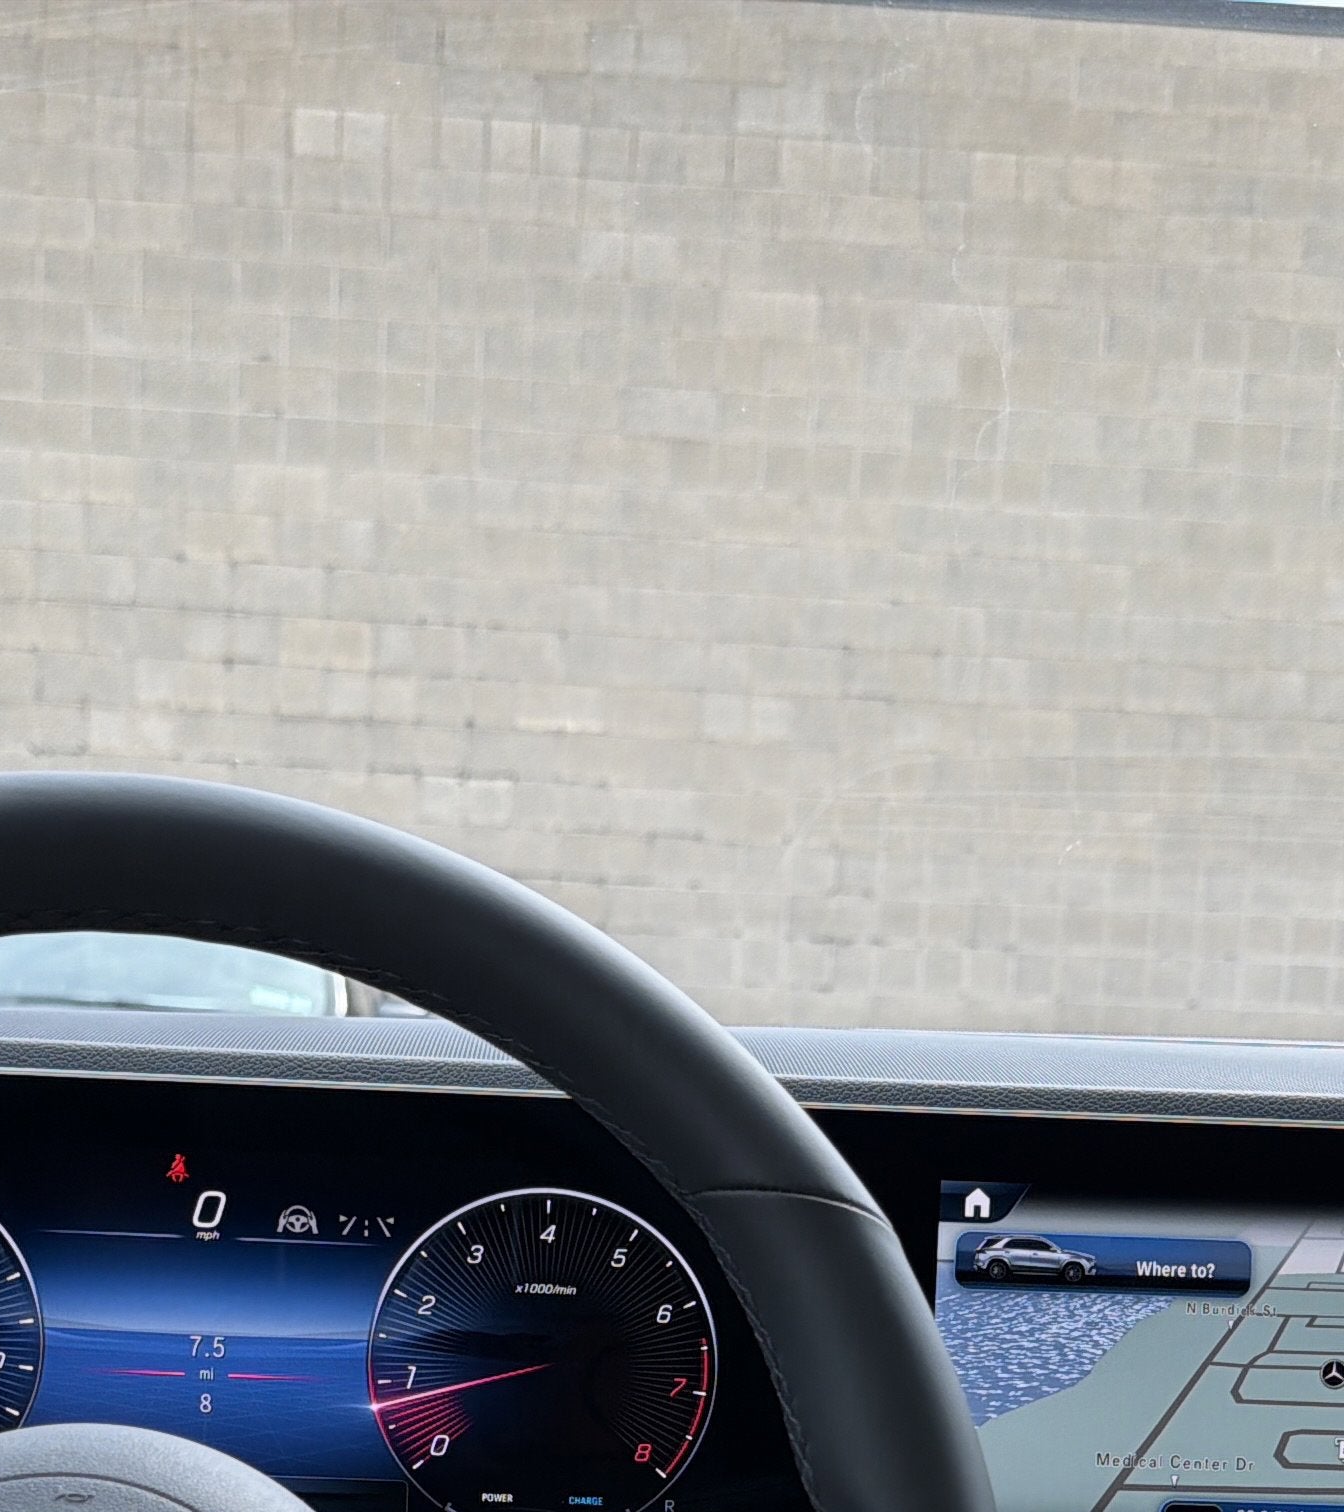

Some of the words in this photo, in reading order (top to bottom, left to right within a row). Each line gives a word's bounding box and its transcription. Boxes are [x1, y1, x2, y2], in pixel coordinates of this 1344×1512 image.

[192, 1190, 227, 1228] 0
[195, 1229, 221, 1242] mph
[539, 1224, 556, 1244] 4
[467, 1245, 485, 1265] 3
[610, 1248, 627, 1268] 5
[1136, 1261, 1185, 1279] Where
[1189, 1263, 1216, 1279] to?
[514, 1282, 577, 1298] x1000/min
[417, 1295, 436, 1316] 2
[655, 1304, 673, 1324] 6
[189, 1336, 226, 1359] 7.5
[199, 1366, 214, 1382] mi
[405, 1367, 417, 1390] 1
[670, 1378, 687, 1397] 7
[199, 1393, 213, 1415] 8
[429, 1434, 451, 1457] 0
[634, 1444, 652, 1464] 8
[1096, 1453, 1164, 1470] Medical
[1170, 1455, 1228, 1472] Center
[1235, 1457, 1255, 1472] Dr
[481, 1492, 514, 1503] POWER
[568, 1495, 604, 1507] CHARGE
